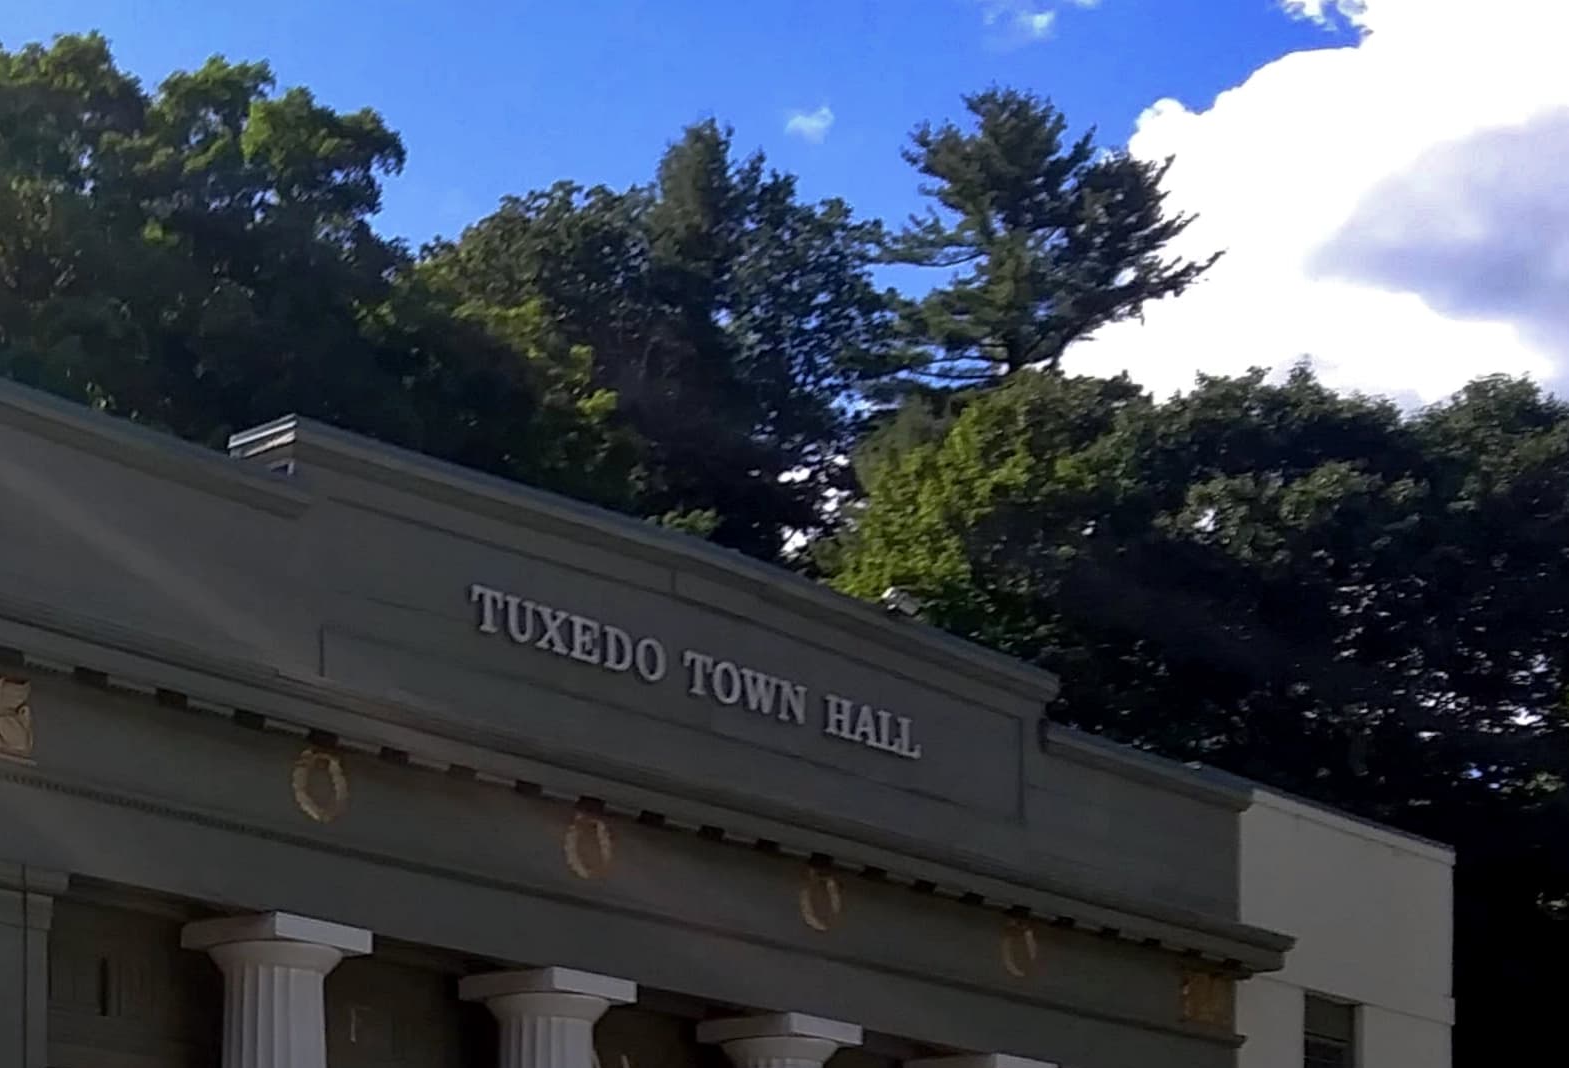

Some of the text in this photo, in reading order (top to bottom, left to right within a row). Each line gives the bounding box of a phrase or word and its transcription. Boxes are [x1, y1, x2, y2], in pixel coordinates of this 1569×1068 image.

[471, 583, 922, 760] TUXEDO TOWN HALL
